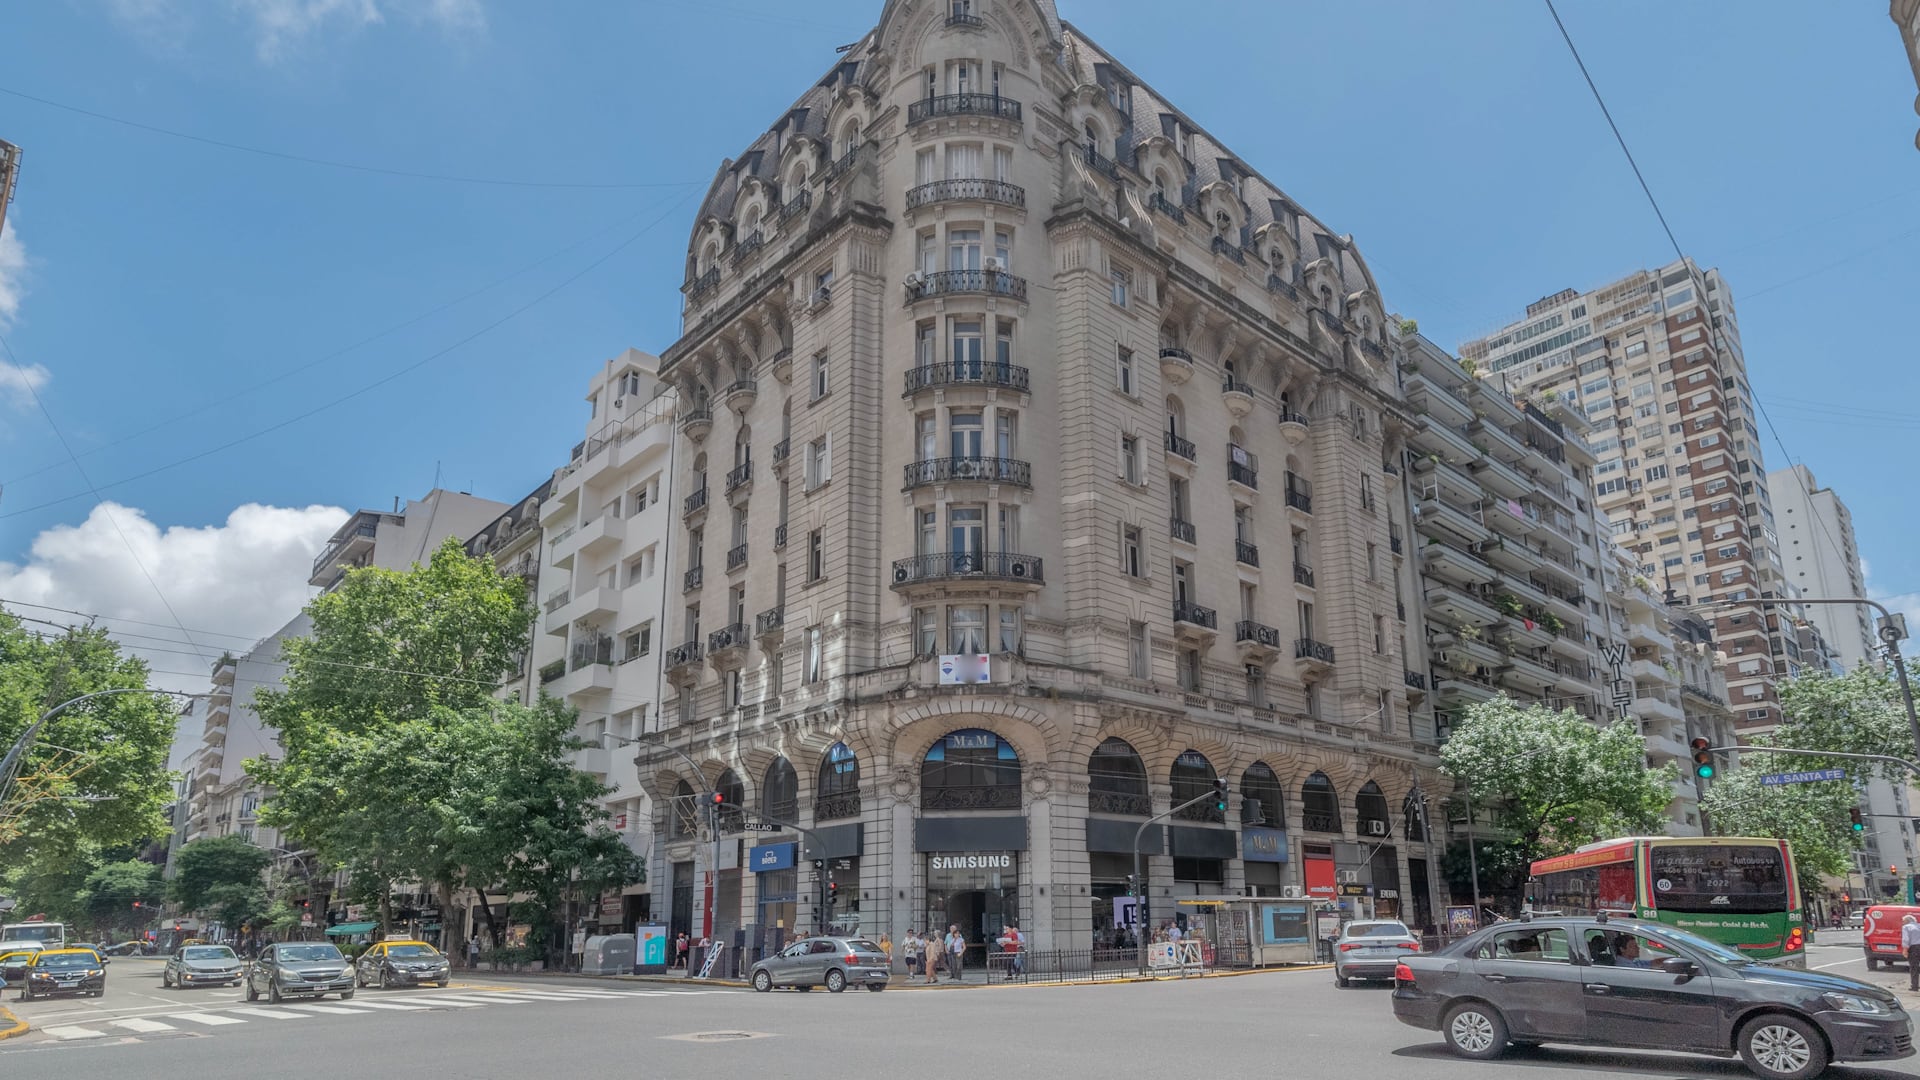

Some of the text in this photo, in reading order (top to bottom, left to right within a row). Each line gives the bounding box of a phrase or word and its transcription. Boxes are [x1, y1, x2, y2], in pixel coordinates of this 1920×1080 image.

[1765, 769, 1842, 785] AV. SANTA FE
[744, 823, 772, 831] CALLAO
[932, 855, 1010, 869] SAMSUNG
[1659, 881, 1670, 889] 60
[1643, 910, 1657, 918] 80
